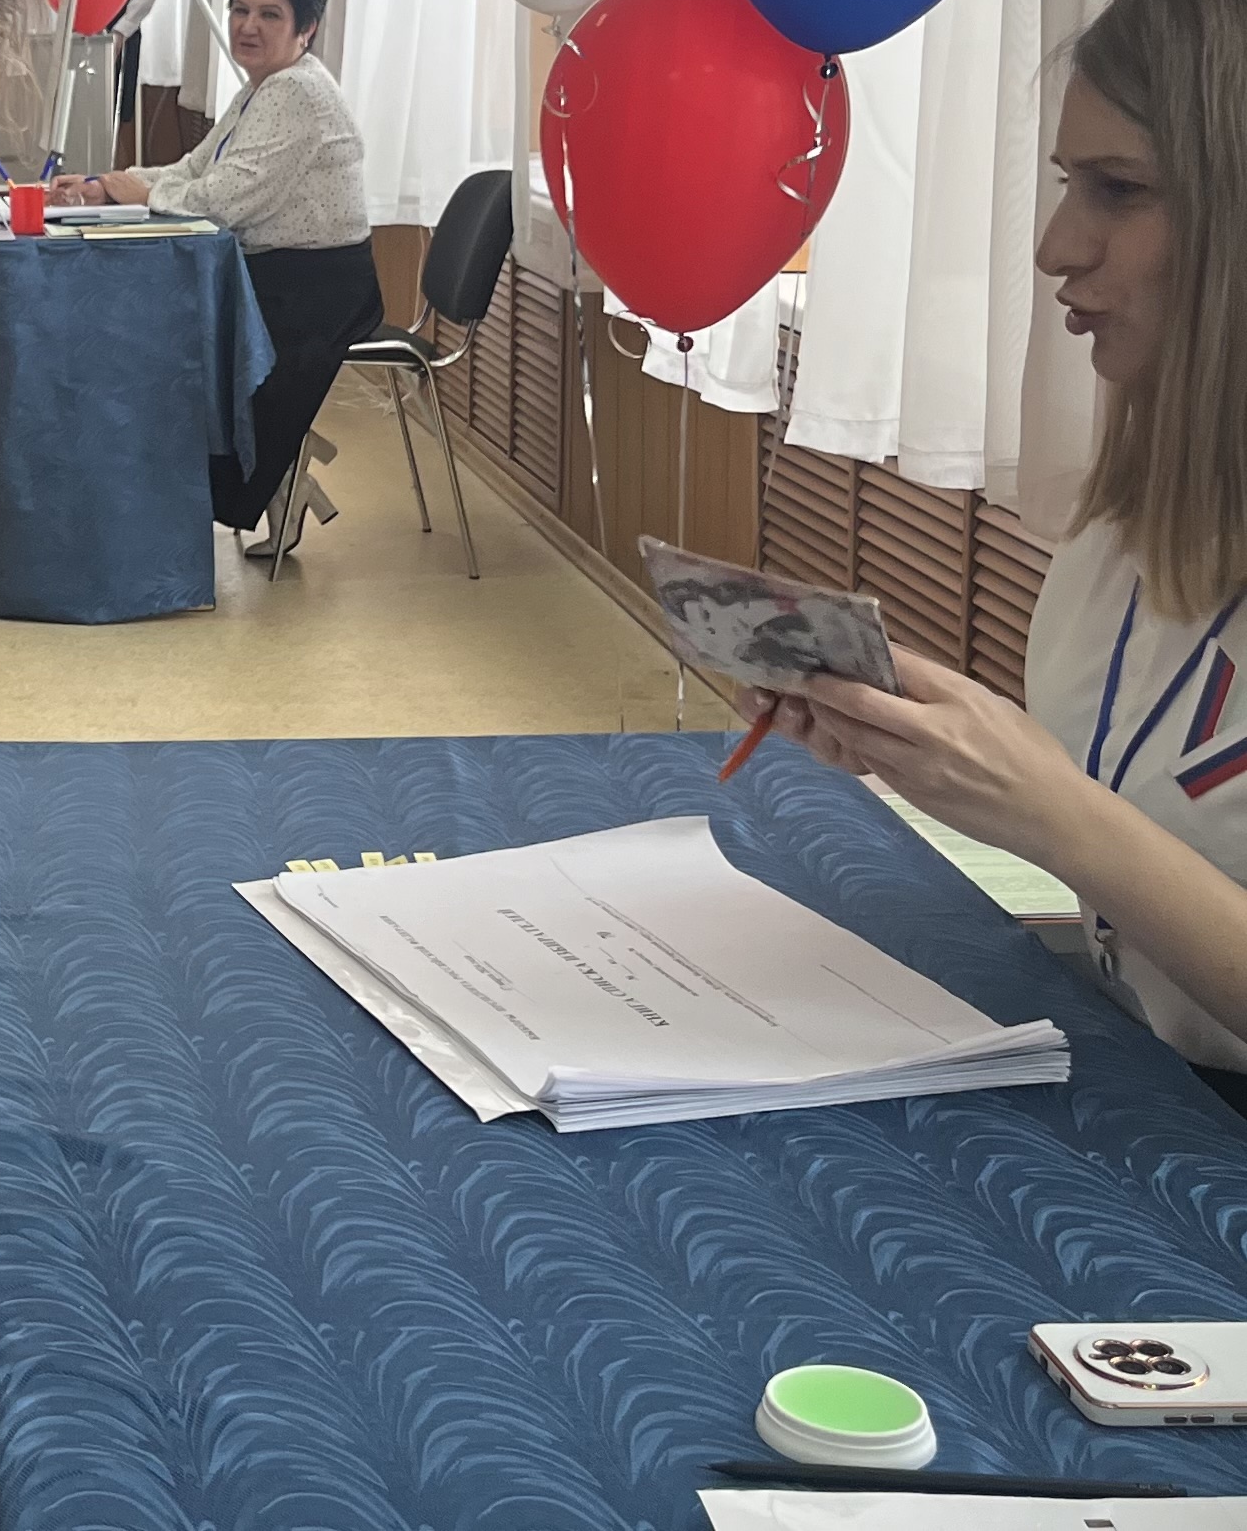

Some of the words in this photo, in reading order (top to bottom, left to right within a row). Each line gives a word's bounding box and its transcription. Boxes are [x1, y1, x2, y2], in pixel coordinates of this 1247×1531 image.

[497, 908, 580, 962] ИЗБИРАТЕЛЕЙ
[575, 962, 627, 997] СПИСКА
[624, 997, 670, 1027] КНИГА
